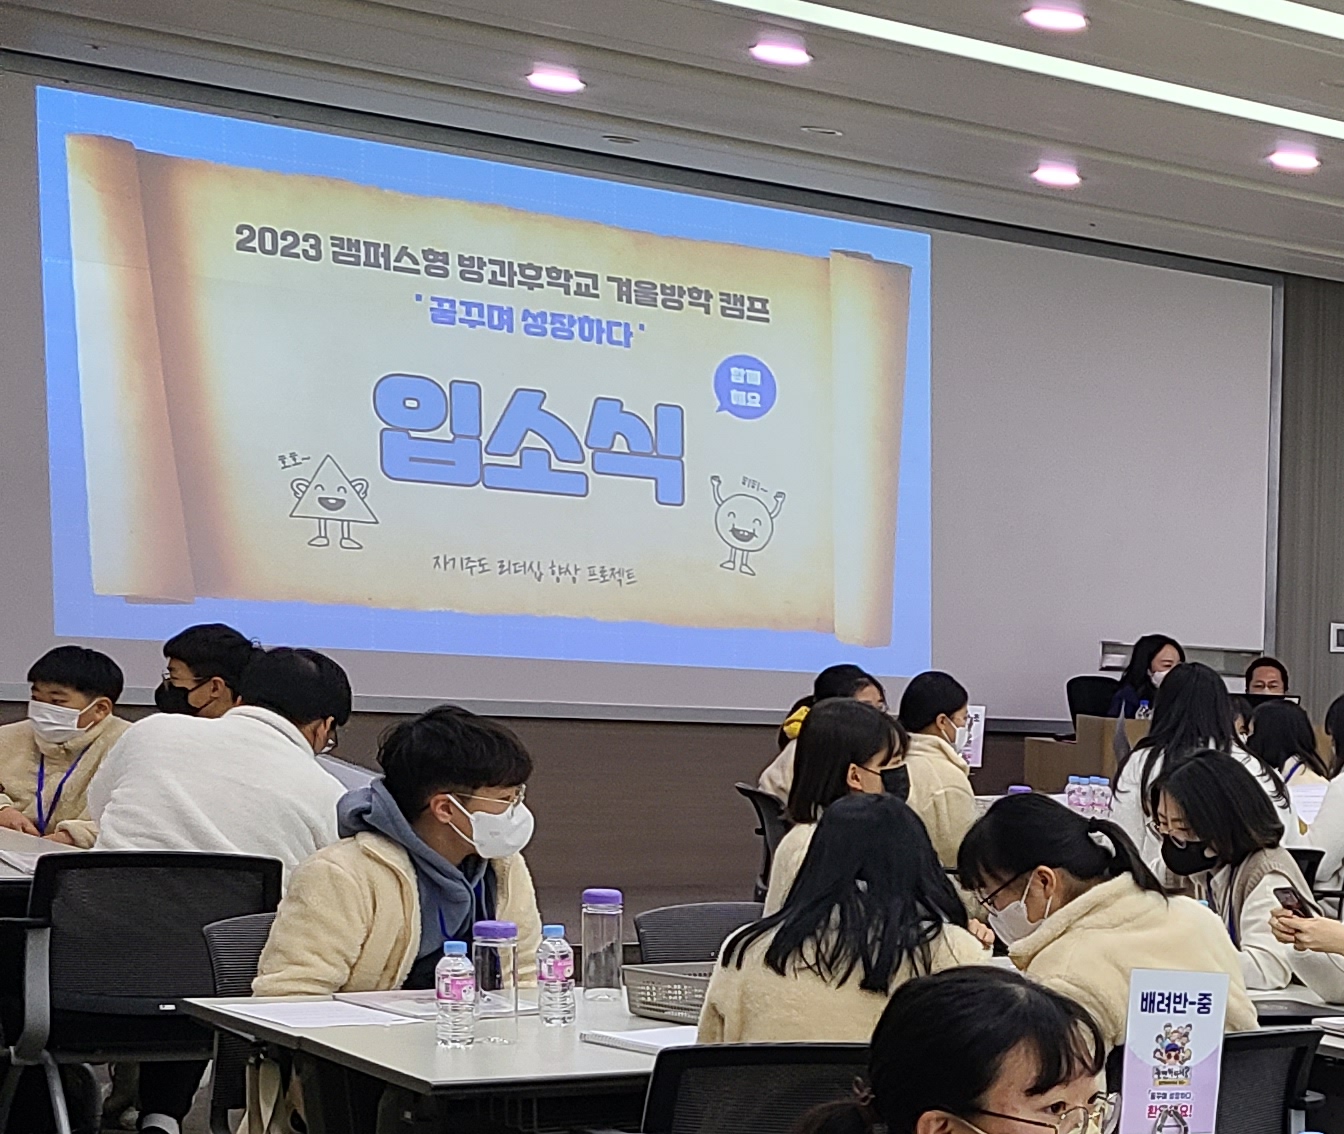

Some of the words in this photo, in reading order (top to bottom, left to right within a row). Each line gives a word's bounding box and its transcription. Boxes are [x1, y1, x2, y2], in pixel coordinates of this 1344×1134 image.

[235, 224, 322, 262] 2023
[330, 236, 449, 278] 캠퍼스형
[458, 253, 600, 299] 방과후학교
[606, 276, 713, 315] 겨울방학
[719, 292, 770, 323] 캠프
[373, 373, 685, 507] 입소식
[433, 554, 491, 576] 자기주도
[497, 559, 544, 582] 리더십
[550, 560, 581, 584] 향상
[587, 565, 638, 587] 프로젝트
[1140, 991, 1212, 1014] 배려반-중
